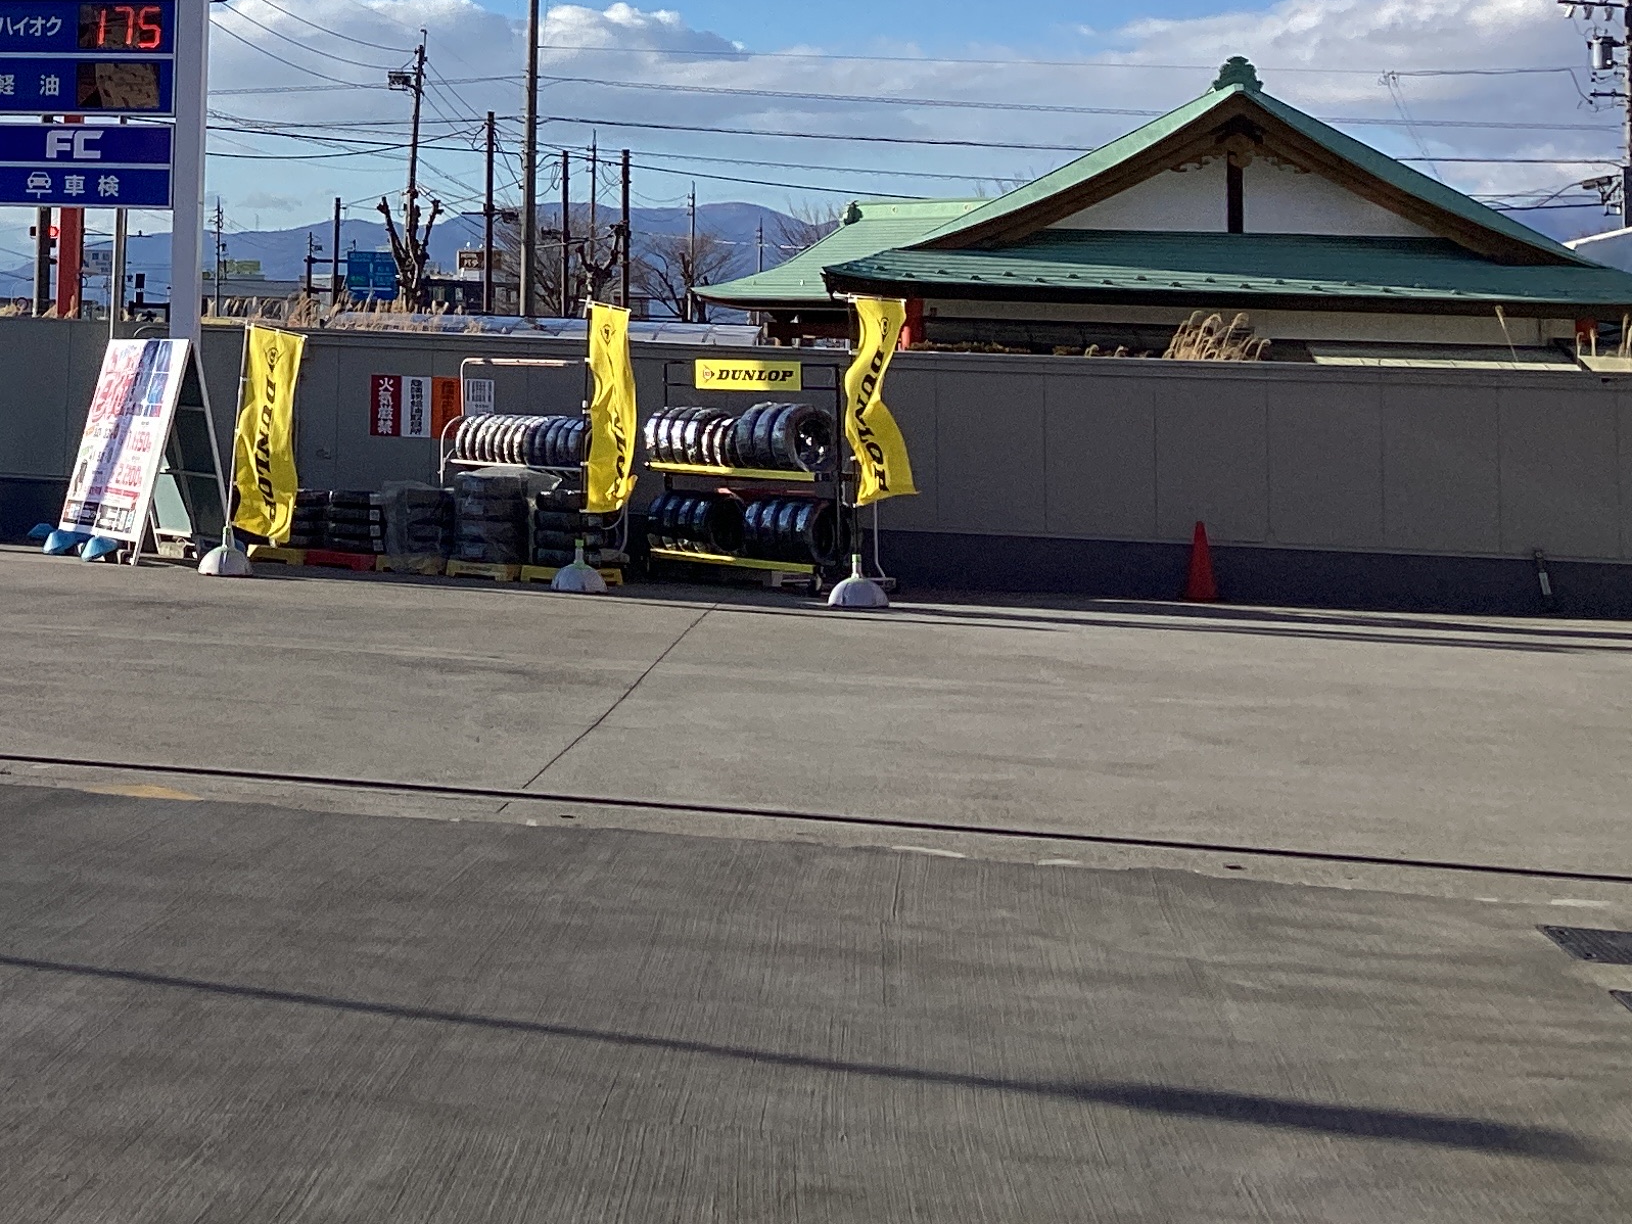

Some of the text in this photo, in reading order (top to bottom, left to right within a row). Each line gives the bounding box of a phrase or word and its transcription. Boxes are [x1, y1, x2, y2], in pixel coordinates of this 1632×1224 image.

[96, 6, 161, 49] 175
[45, 130, 105, 159] FC
[63, 174, 120, 197] 車検
[716, 368, 794, 382] DUNLOP
[377, 377, 394, 435] 火気厳禁
